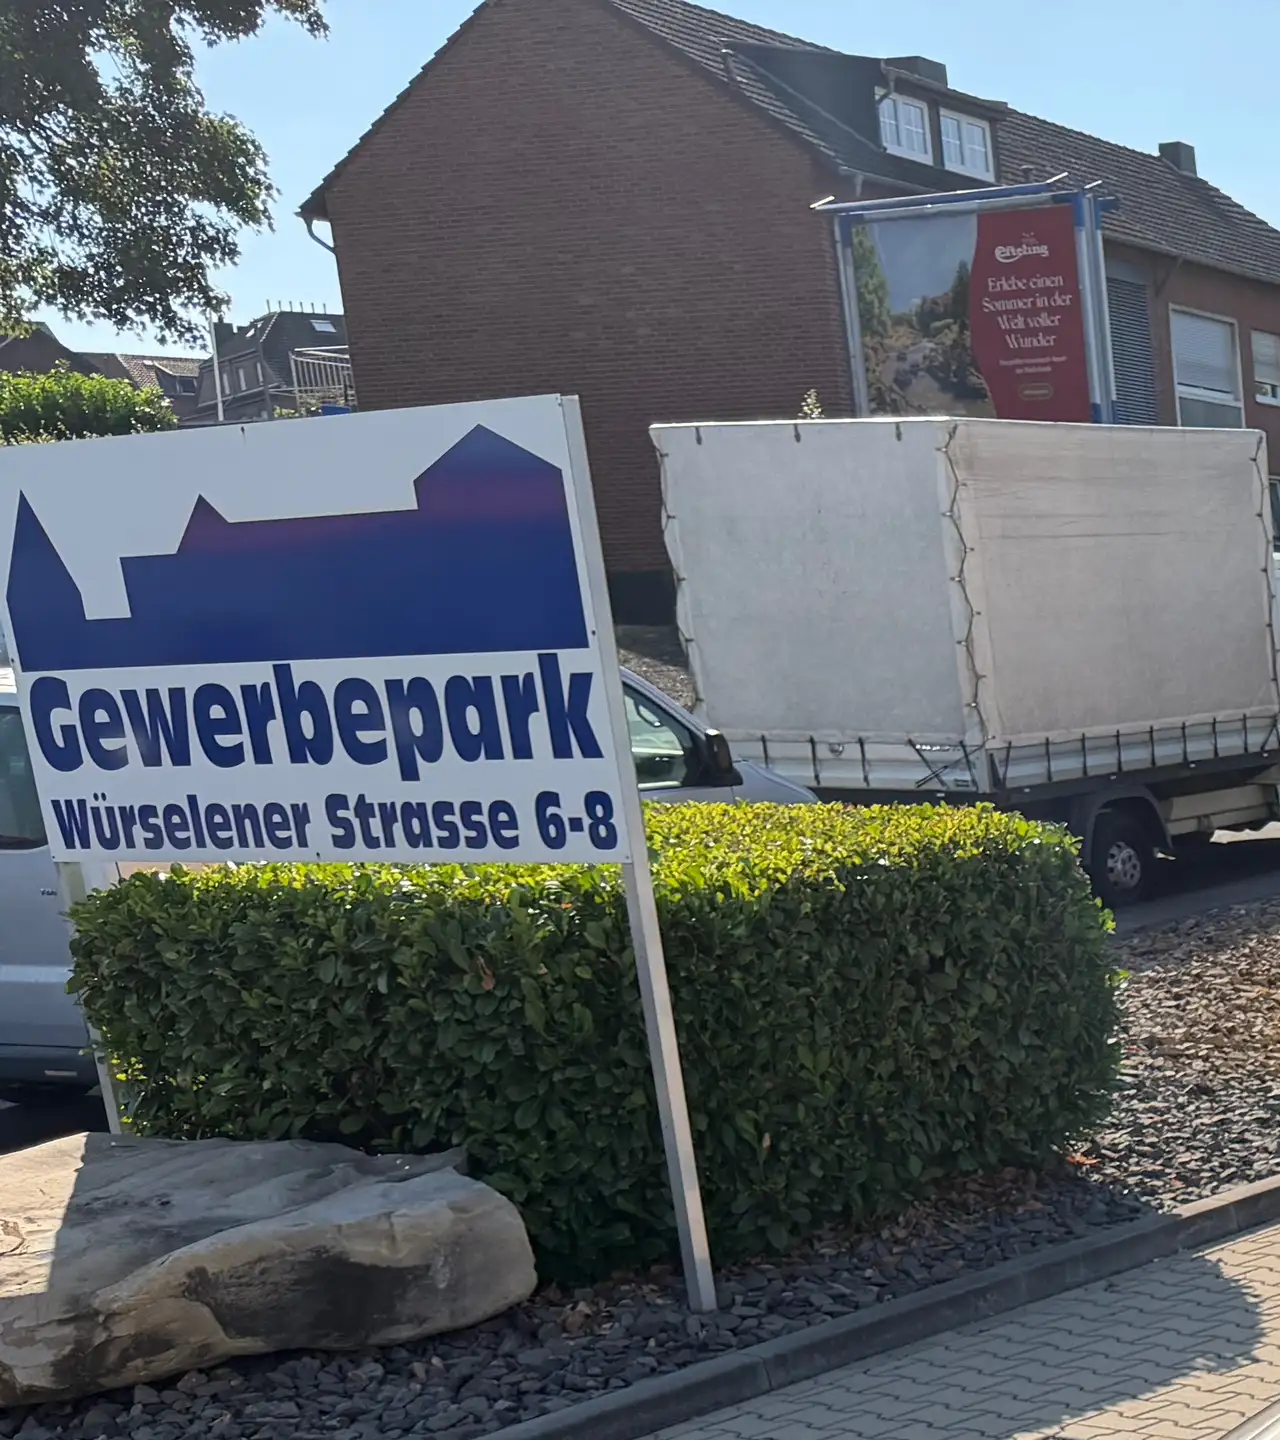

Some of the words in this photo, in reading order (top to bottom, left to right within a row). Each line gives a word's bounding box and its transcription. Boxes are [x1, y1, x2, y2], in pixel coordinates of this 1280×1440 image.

[1029, 274, 1064, 288] einen
[982, 297, 1034, 312] Sommer
[1035, 293, 1048, 307] in
[1050, 291, 1072, 306] der
[997, 314, 1025, 329] Welt
[1027, 312, 1061, 328] voller
[1005, 332, 1056, 349] Wunder
[28, 652, 605, 781] Gewerbepark
[51, 792, 310, 850] Würselener
[325, 792, 520, 850] Strasse
[536, 790, 619, 850] 6-8
